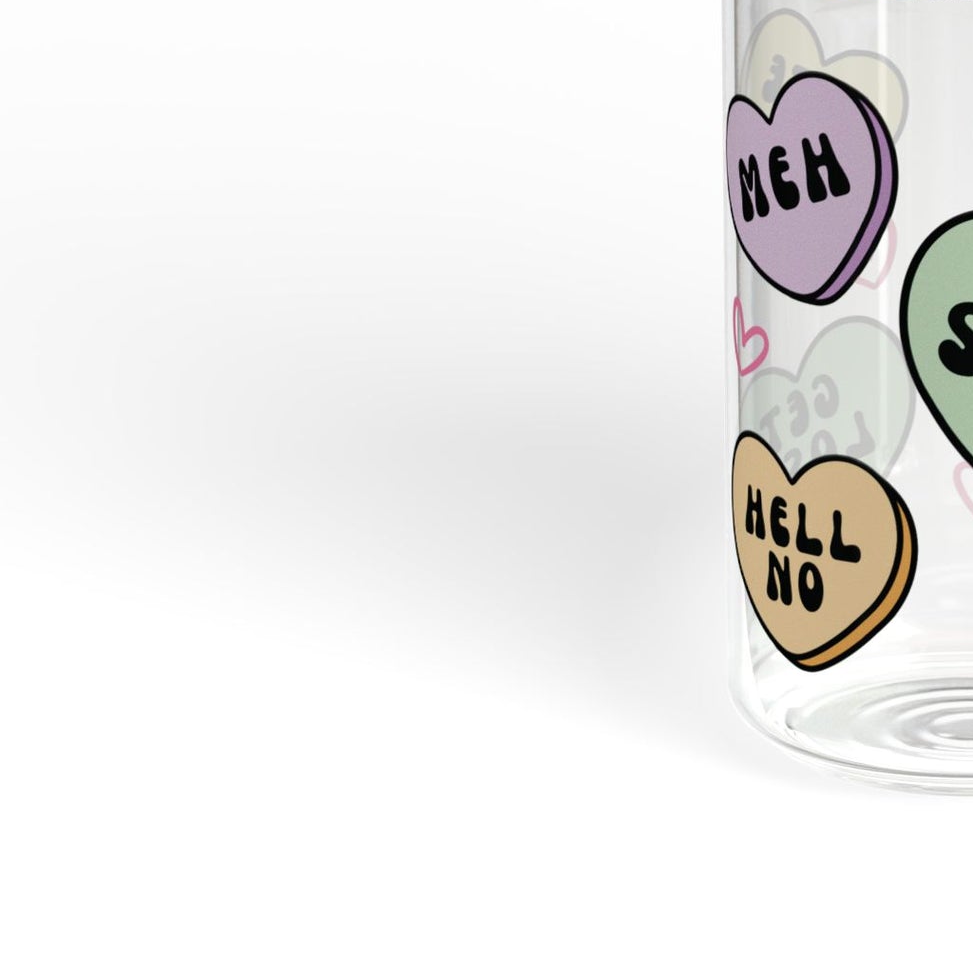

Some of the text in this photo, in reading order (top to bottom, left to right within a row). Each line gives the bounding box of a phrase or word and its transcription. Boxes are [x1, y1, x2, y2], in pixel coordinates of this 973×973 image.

[738, 132, 851, 223] MEH
[745, 484, 861, 563] HELL
[766, 550, 824, 613] NO
